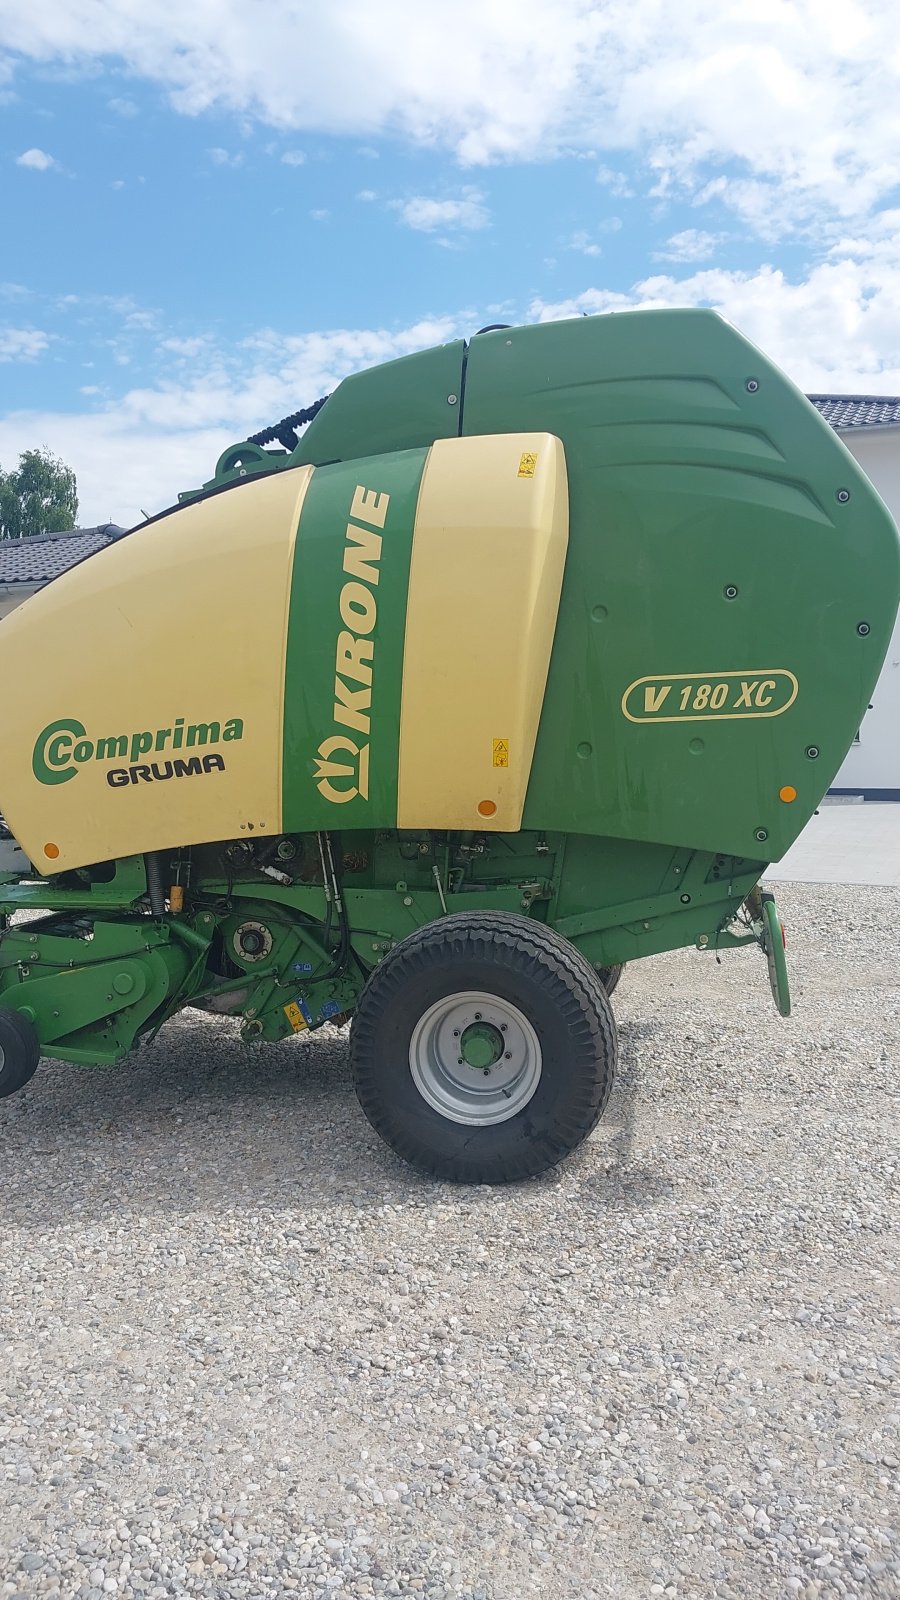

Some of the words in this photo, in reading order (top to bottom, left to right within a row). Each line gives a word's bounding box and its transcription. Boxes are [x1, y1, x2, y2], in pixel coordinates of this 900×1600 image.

[334, 485, 390, 735] KRONE
[644, 686, 672, 712] V
[679, 683, 729, 711] 180
[733, 680, 776, 708] XC
[32, 718, 244, 785] Comprima
[106, 753, 226, 788] GRUMA
